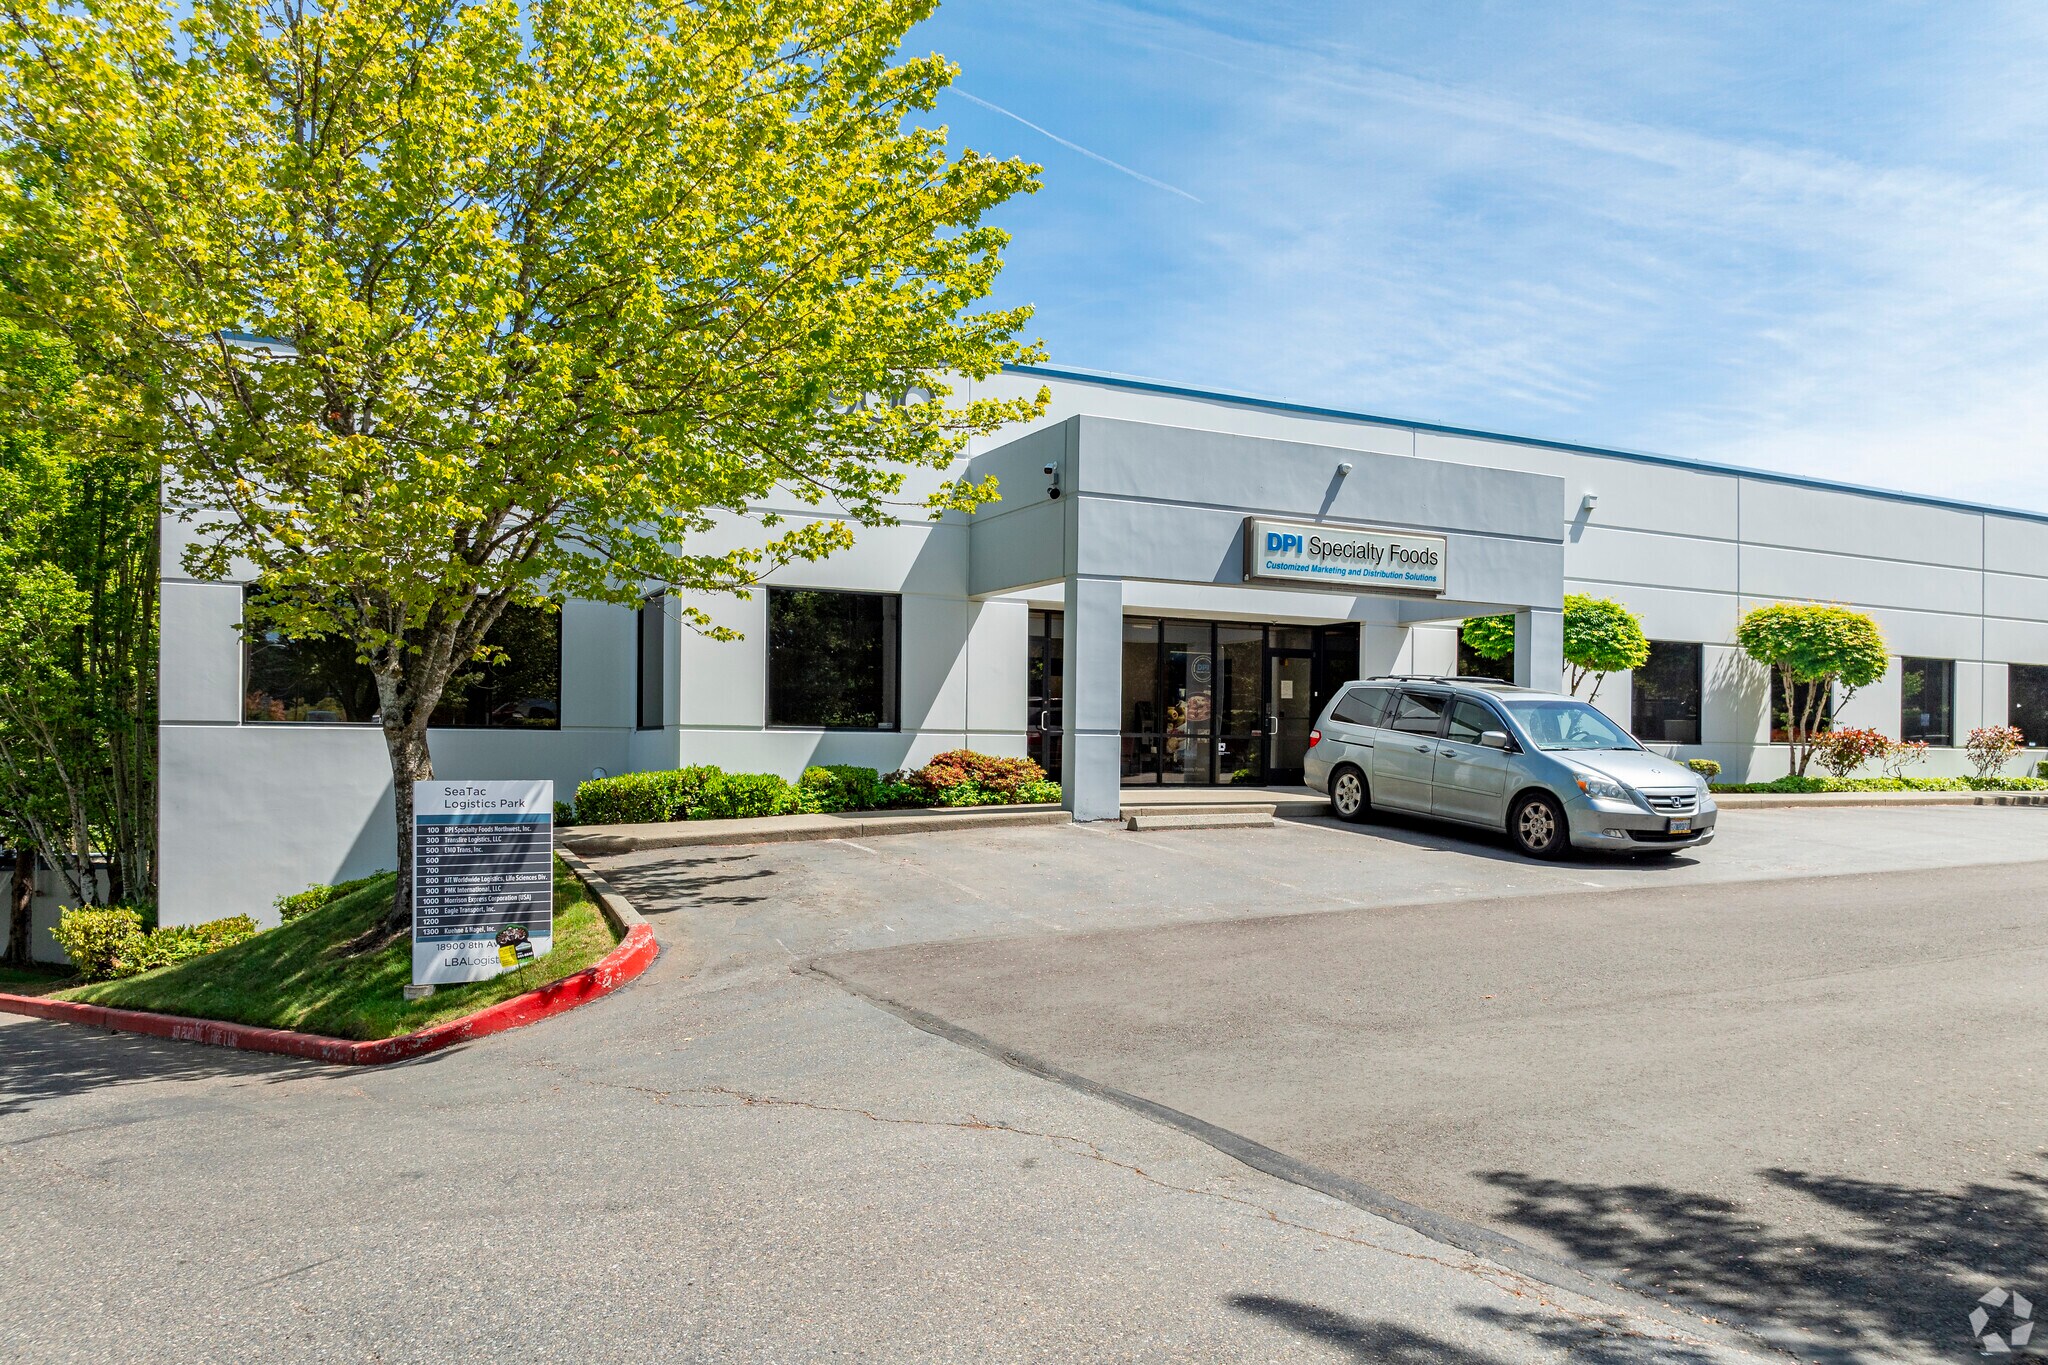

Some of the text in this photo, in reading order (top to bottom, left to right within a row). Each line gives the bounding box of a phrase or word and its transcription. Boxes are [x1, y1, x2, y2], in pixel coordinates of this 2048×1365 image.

[1267, 532, 1439, 566] DPI Specialty Foods
[1266, 560, 1437, 582] Customized Marketing and Distribution Solutions
[444, 787, 486, 796] SeaTac
[444, 798, 526, 810] Logistics Park
[444, 956, 500, 968] LBALogist
